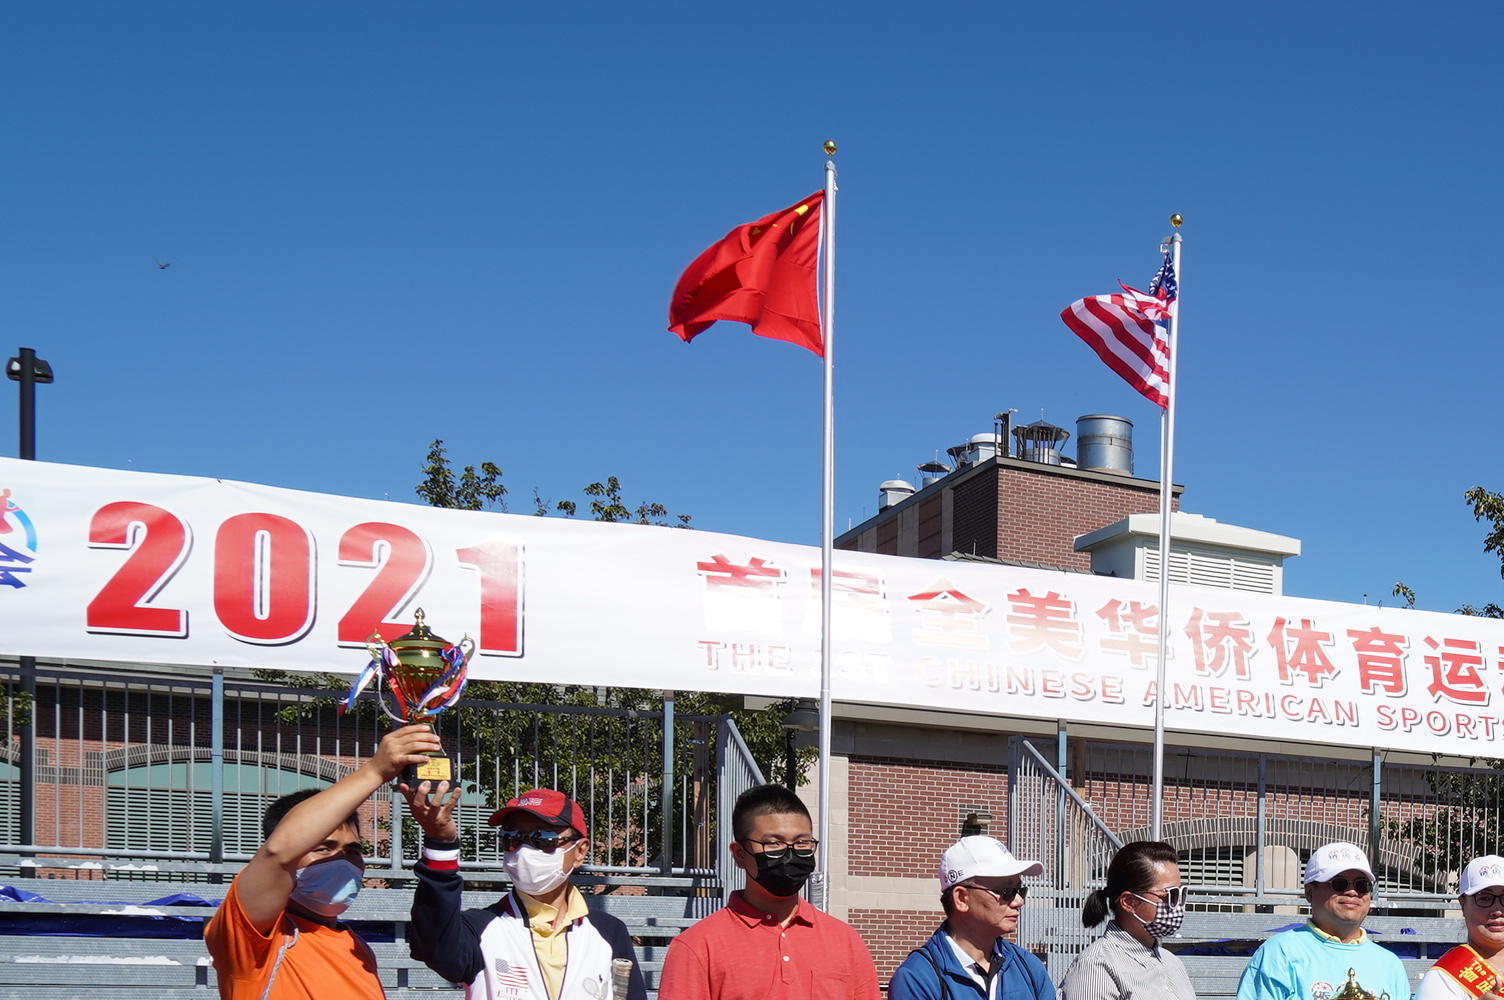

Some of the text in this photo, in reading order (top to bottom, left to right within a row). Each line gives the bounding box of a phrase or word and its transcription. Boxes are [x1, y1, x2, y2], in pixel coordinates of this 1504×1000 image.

[87, 501, 526, 657] 2021
[698, 641, 793, 676] THE
[914, 656, 1125, 704] CHINESE
[1143, 680, 1360, 728] AMERICAN
